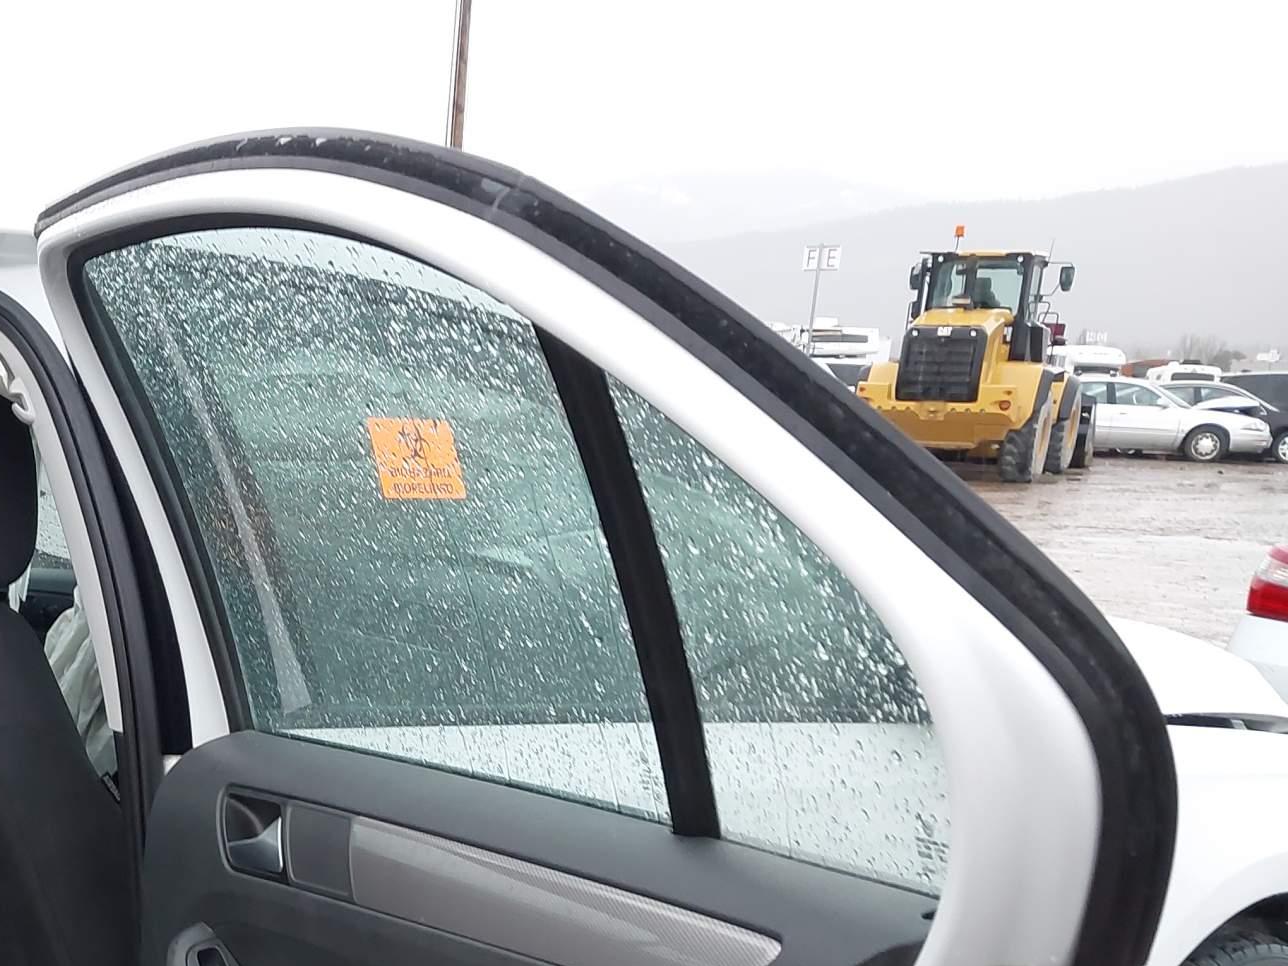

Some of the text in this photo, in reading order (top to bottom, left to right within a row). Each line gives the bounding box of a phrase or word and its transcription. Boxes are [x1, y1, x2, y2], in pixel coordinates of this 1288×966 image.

[806, 248, 838, 268] F E
[937, 326, 953, 337] CAT
